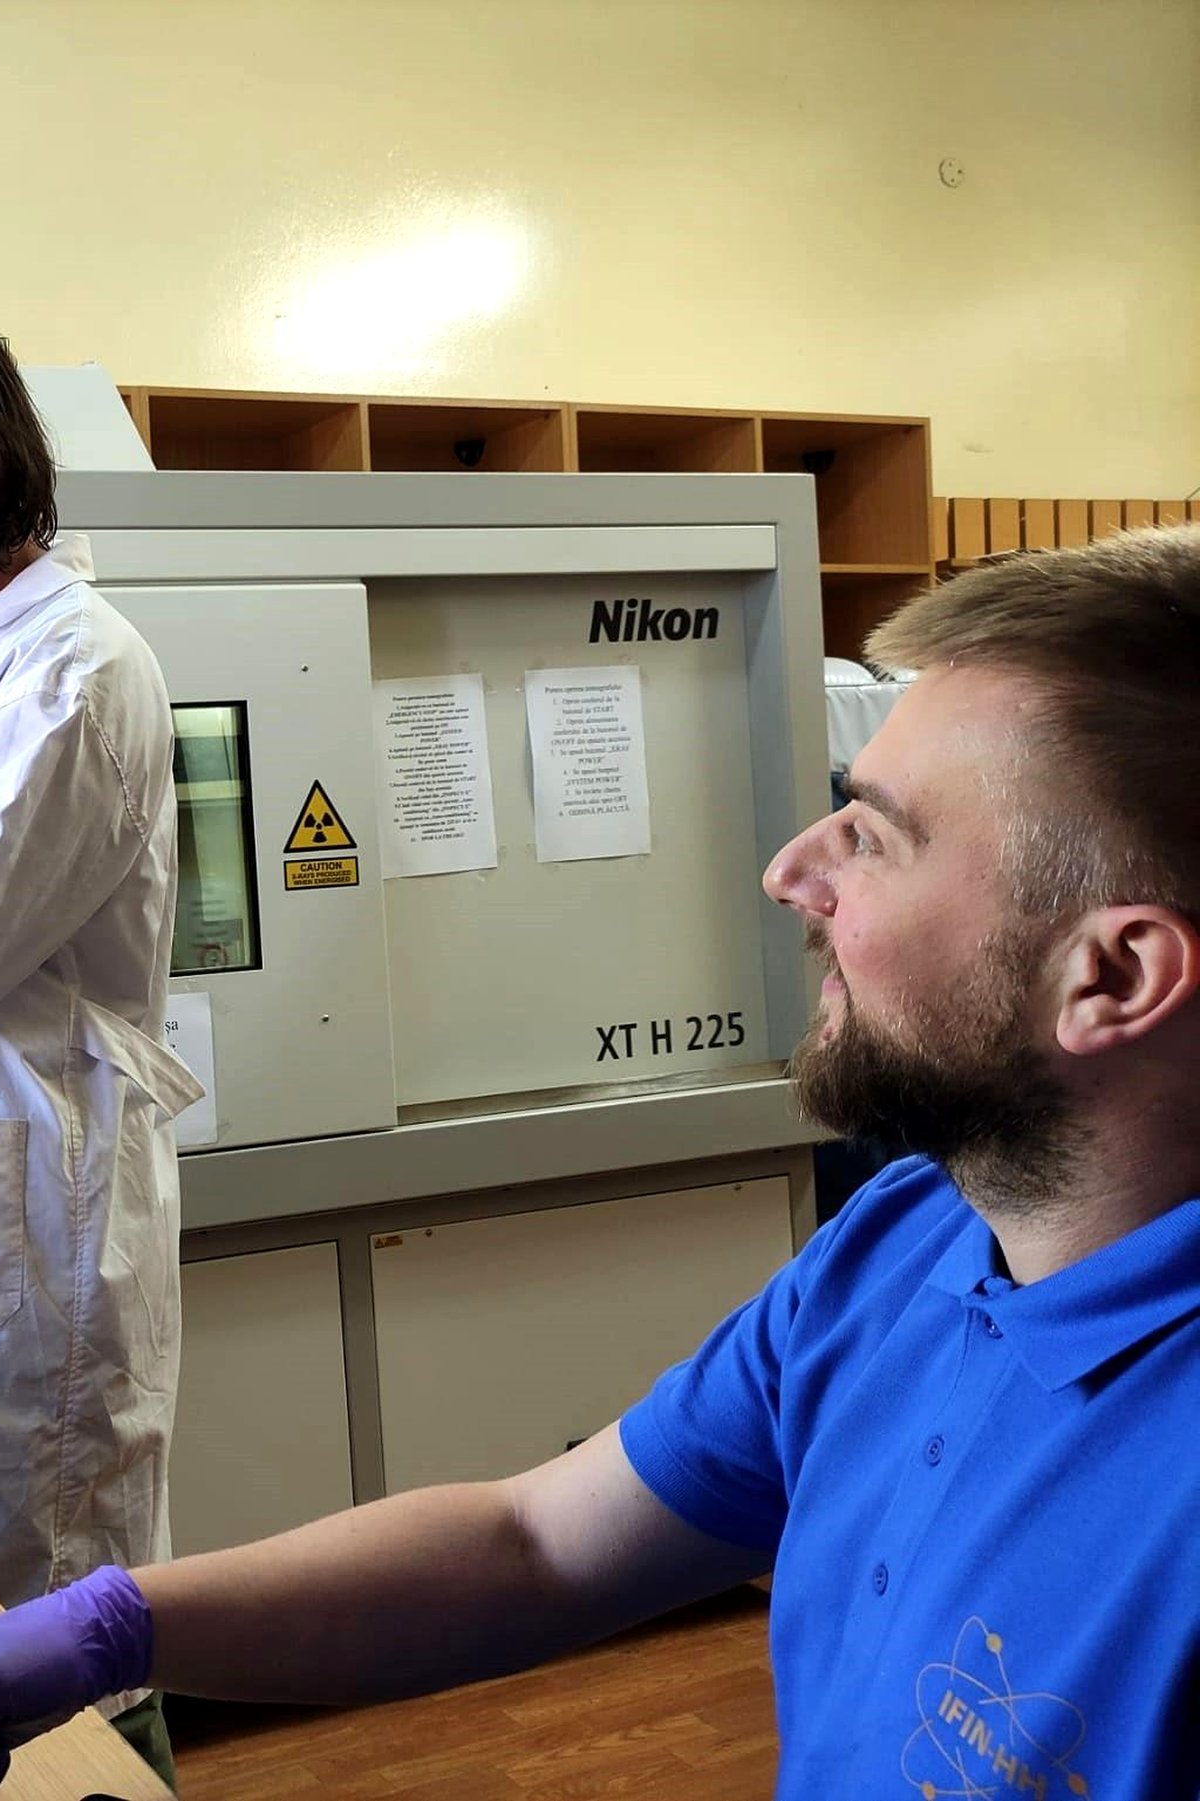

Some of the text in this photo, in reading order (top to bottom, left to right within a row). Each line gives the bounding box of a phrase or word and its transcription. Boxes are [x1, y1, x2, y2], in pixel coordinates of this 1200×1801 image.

[589, 598, 719, 643] Nikon
[300, 861, 342, 872] CAUTION
[316, 870, 351, 878] PRODUCED
[596, 1012, 744, 1061] XT H 225
